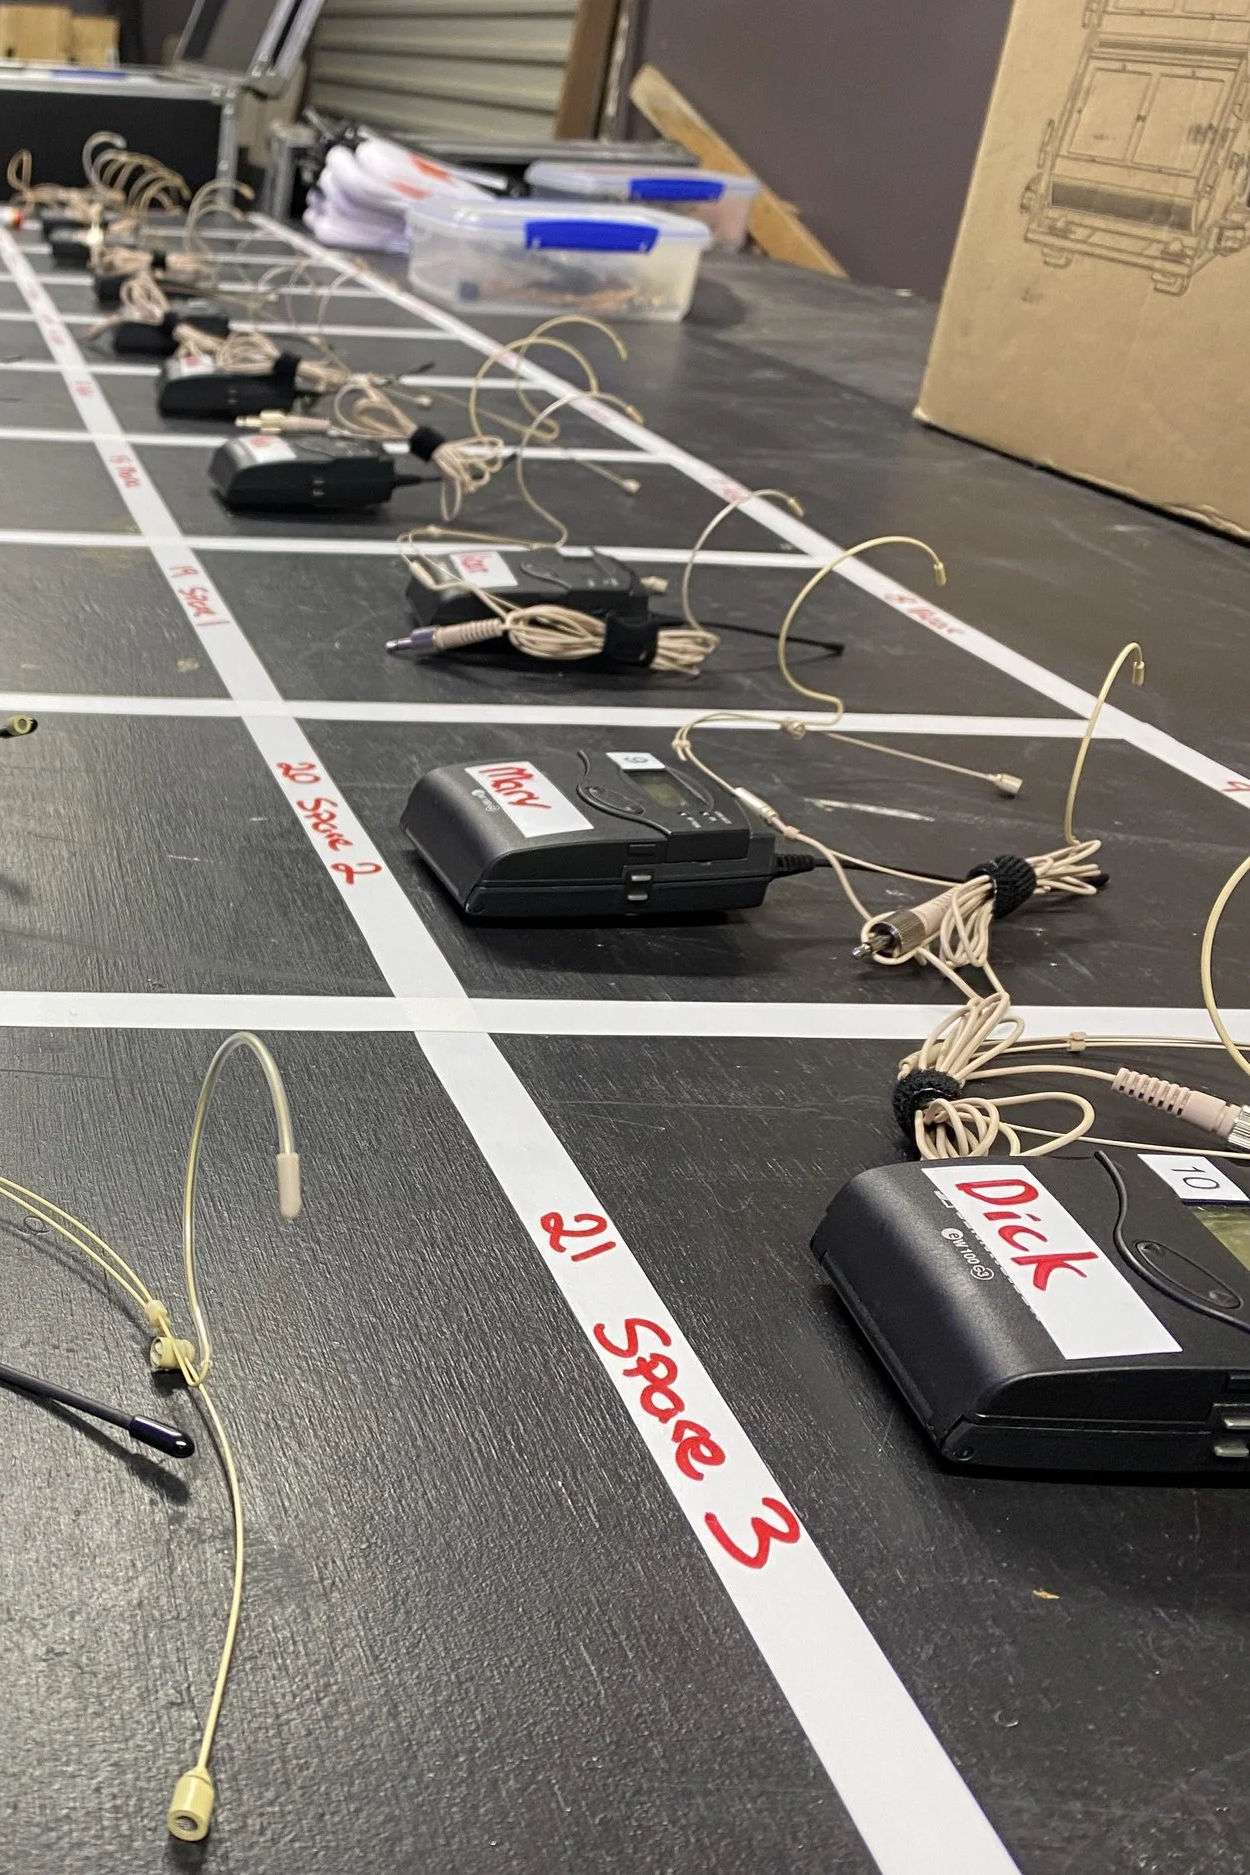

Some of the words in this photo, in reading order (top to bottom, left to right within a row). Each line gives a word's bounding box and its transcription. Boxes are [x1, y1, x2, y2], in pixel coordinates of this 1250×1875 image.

[276, 762, 321, 784] 20
[478, 765, 552, 809] Mary
[296, 797, 354, 851] Spare
[330, 862, 383, 886] 2
[1170, 1166, 1221, 1190] 10
[954, 1178, 1100, 1292] Dick
[539, 1211, 617, 1262] 21
[592, 1317, 727, 1482] Spare
[703, 1496, 802, 1570] 3
